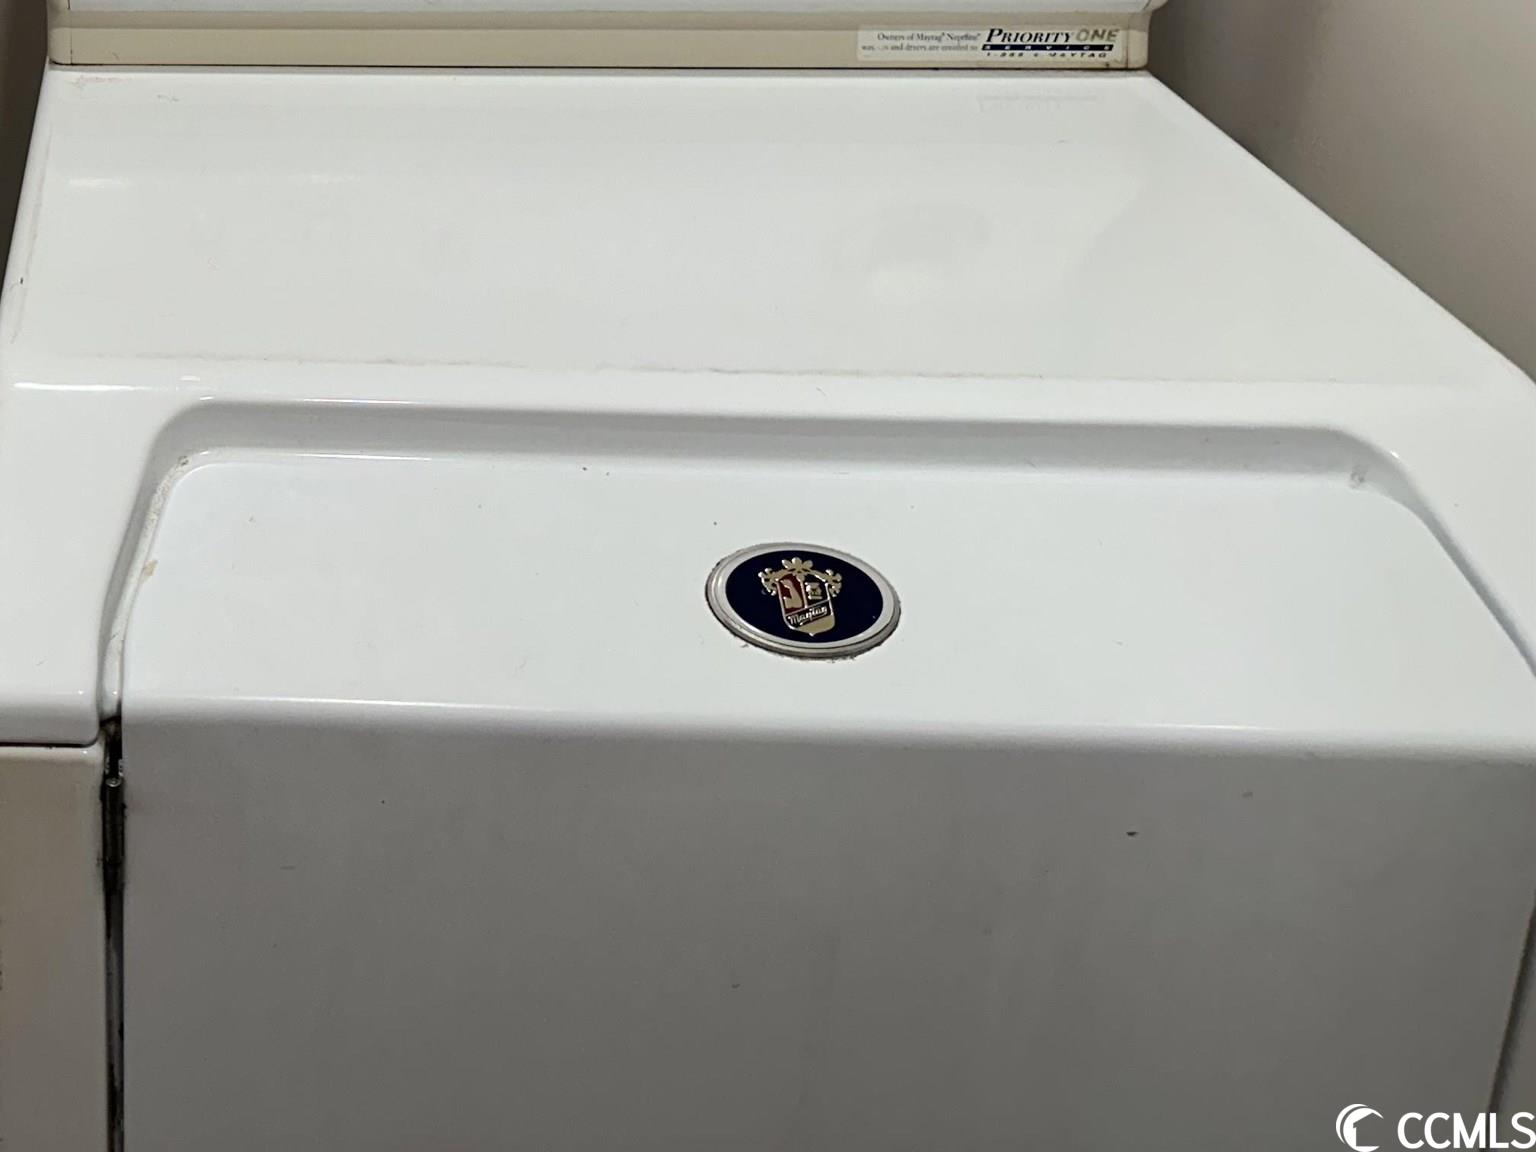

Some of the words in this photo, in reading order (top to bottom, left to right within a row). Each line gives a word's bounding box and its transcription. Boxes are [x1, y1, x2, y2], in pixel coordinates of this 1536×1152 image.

[986, 28, 1070, 42] PRIORITY
[1075, 28, 1120, 42] ONE
[788, 606, 828, 625] Maytag
